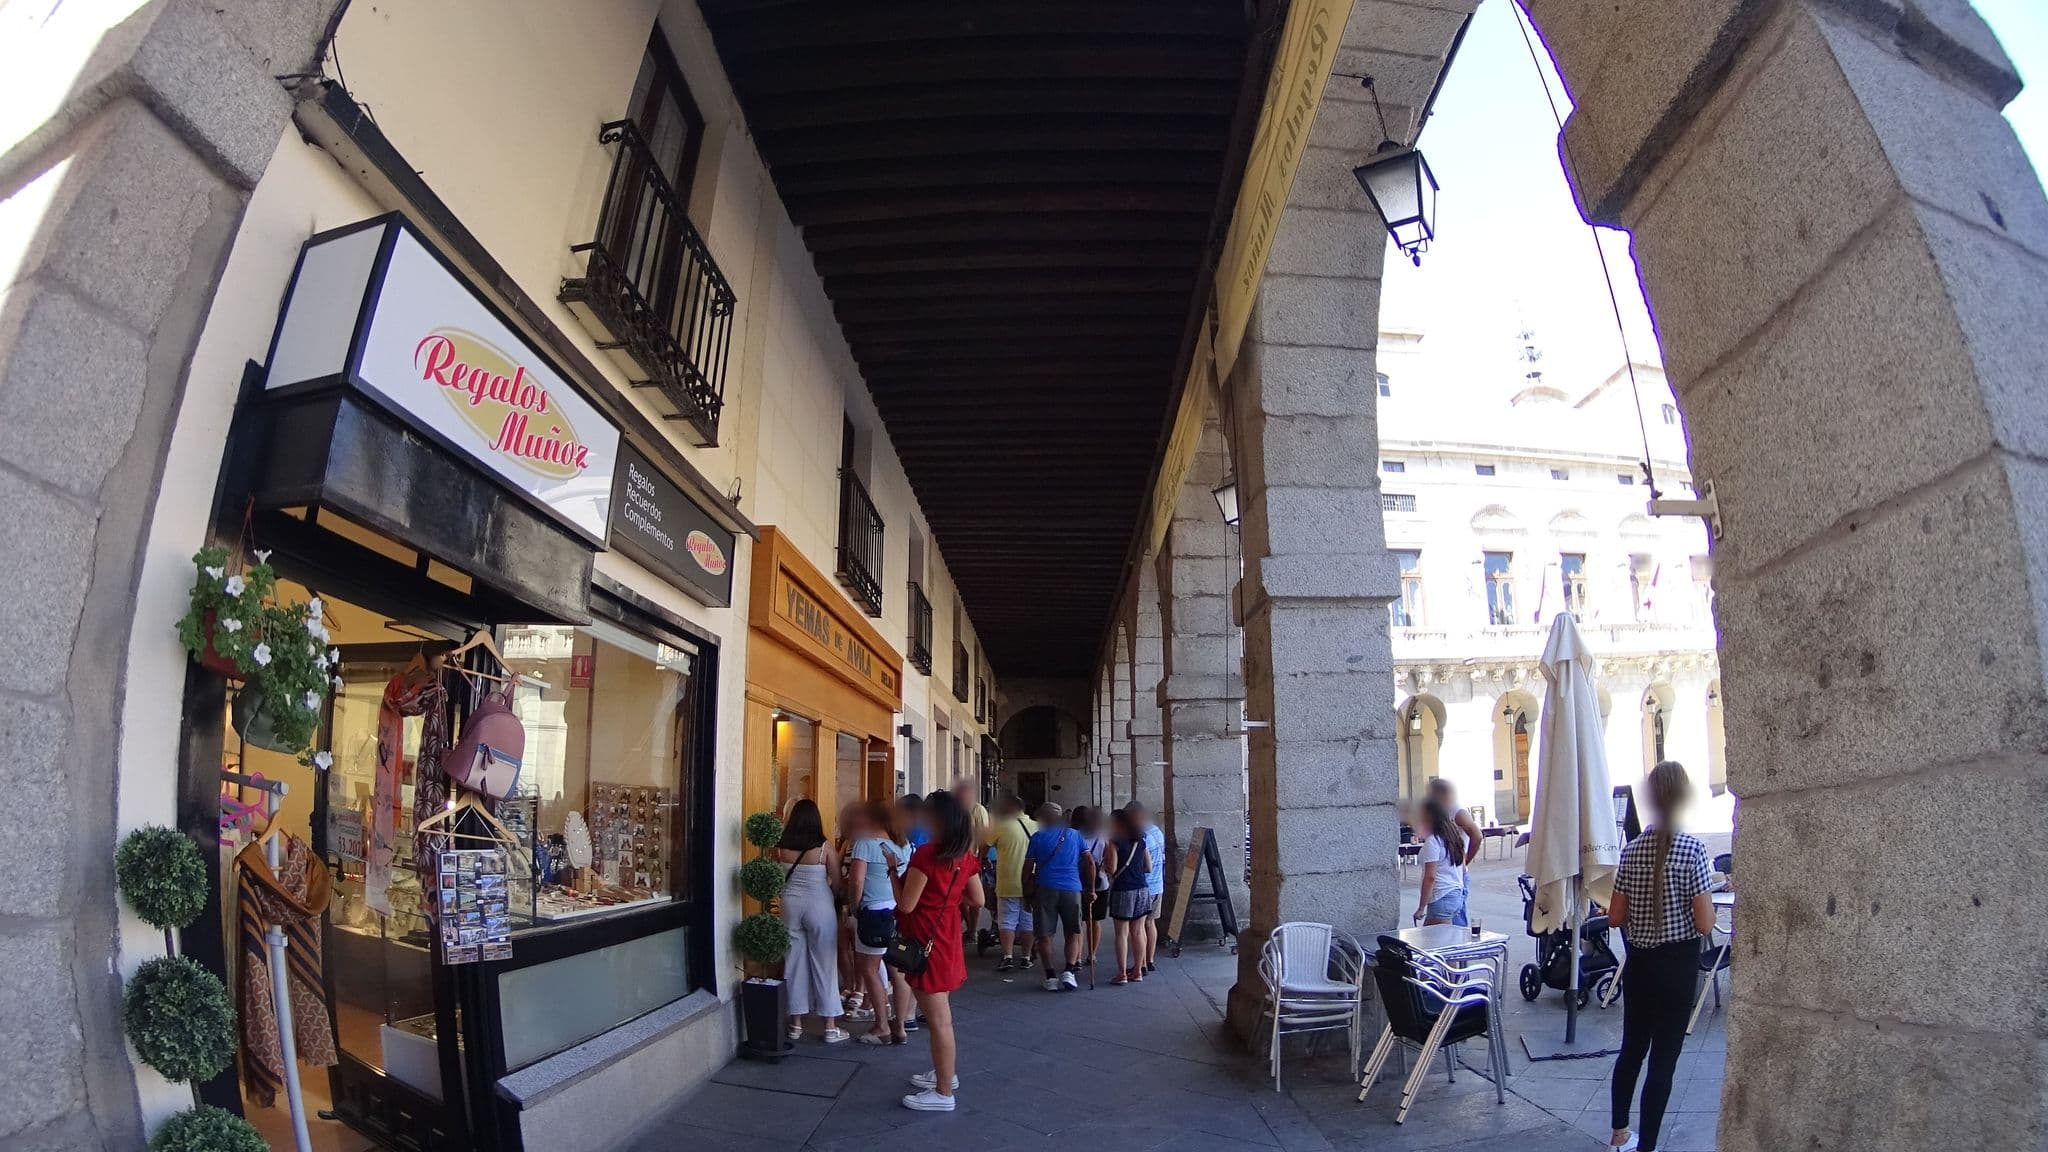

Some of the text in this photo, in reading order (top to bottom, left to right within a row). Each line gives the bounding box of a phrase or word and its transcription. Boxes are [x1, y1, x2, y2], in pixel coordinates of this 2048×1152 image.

[414, 335, 550, 415] Regalos
[488, 411, 590, 469] Muñoz
[626, 482, 662, 522] Recuerdos
[628, 463, 656, 497] Regalos
[624, 502, 674, 550] Complementos
[786, 584, 829, 645] YEMAS
